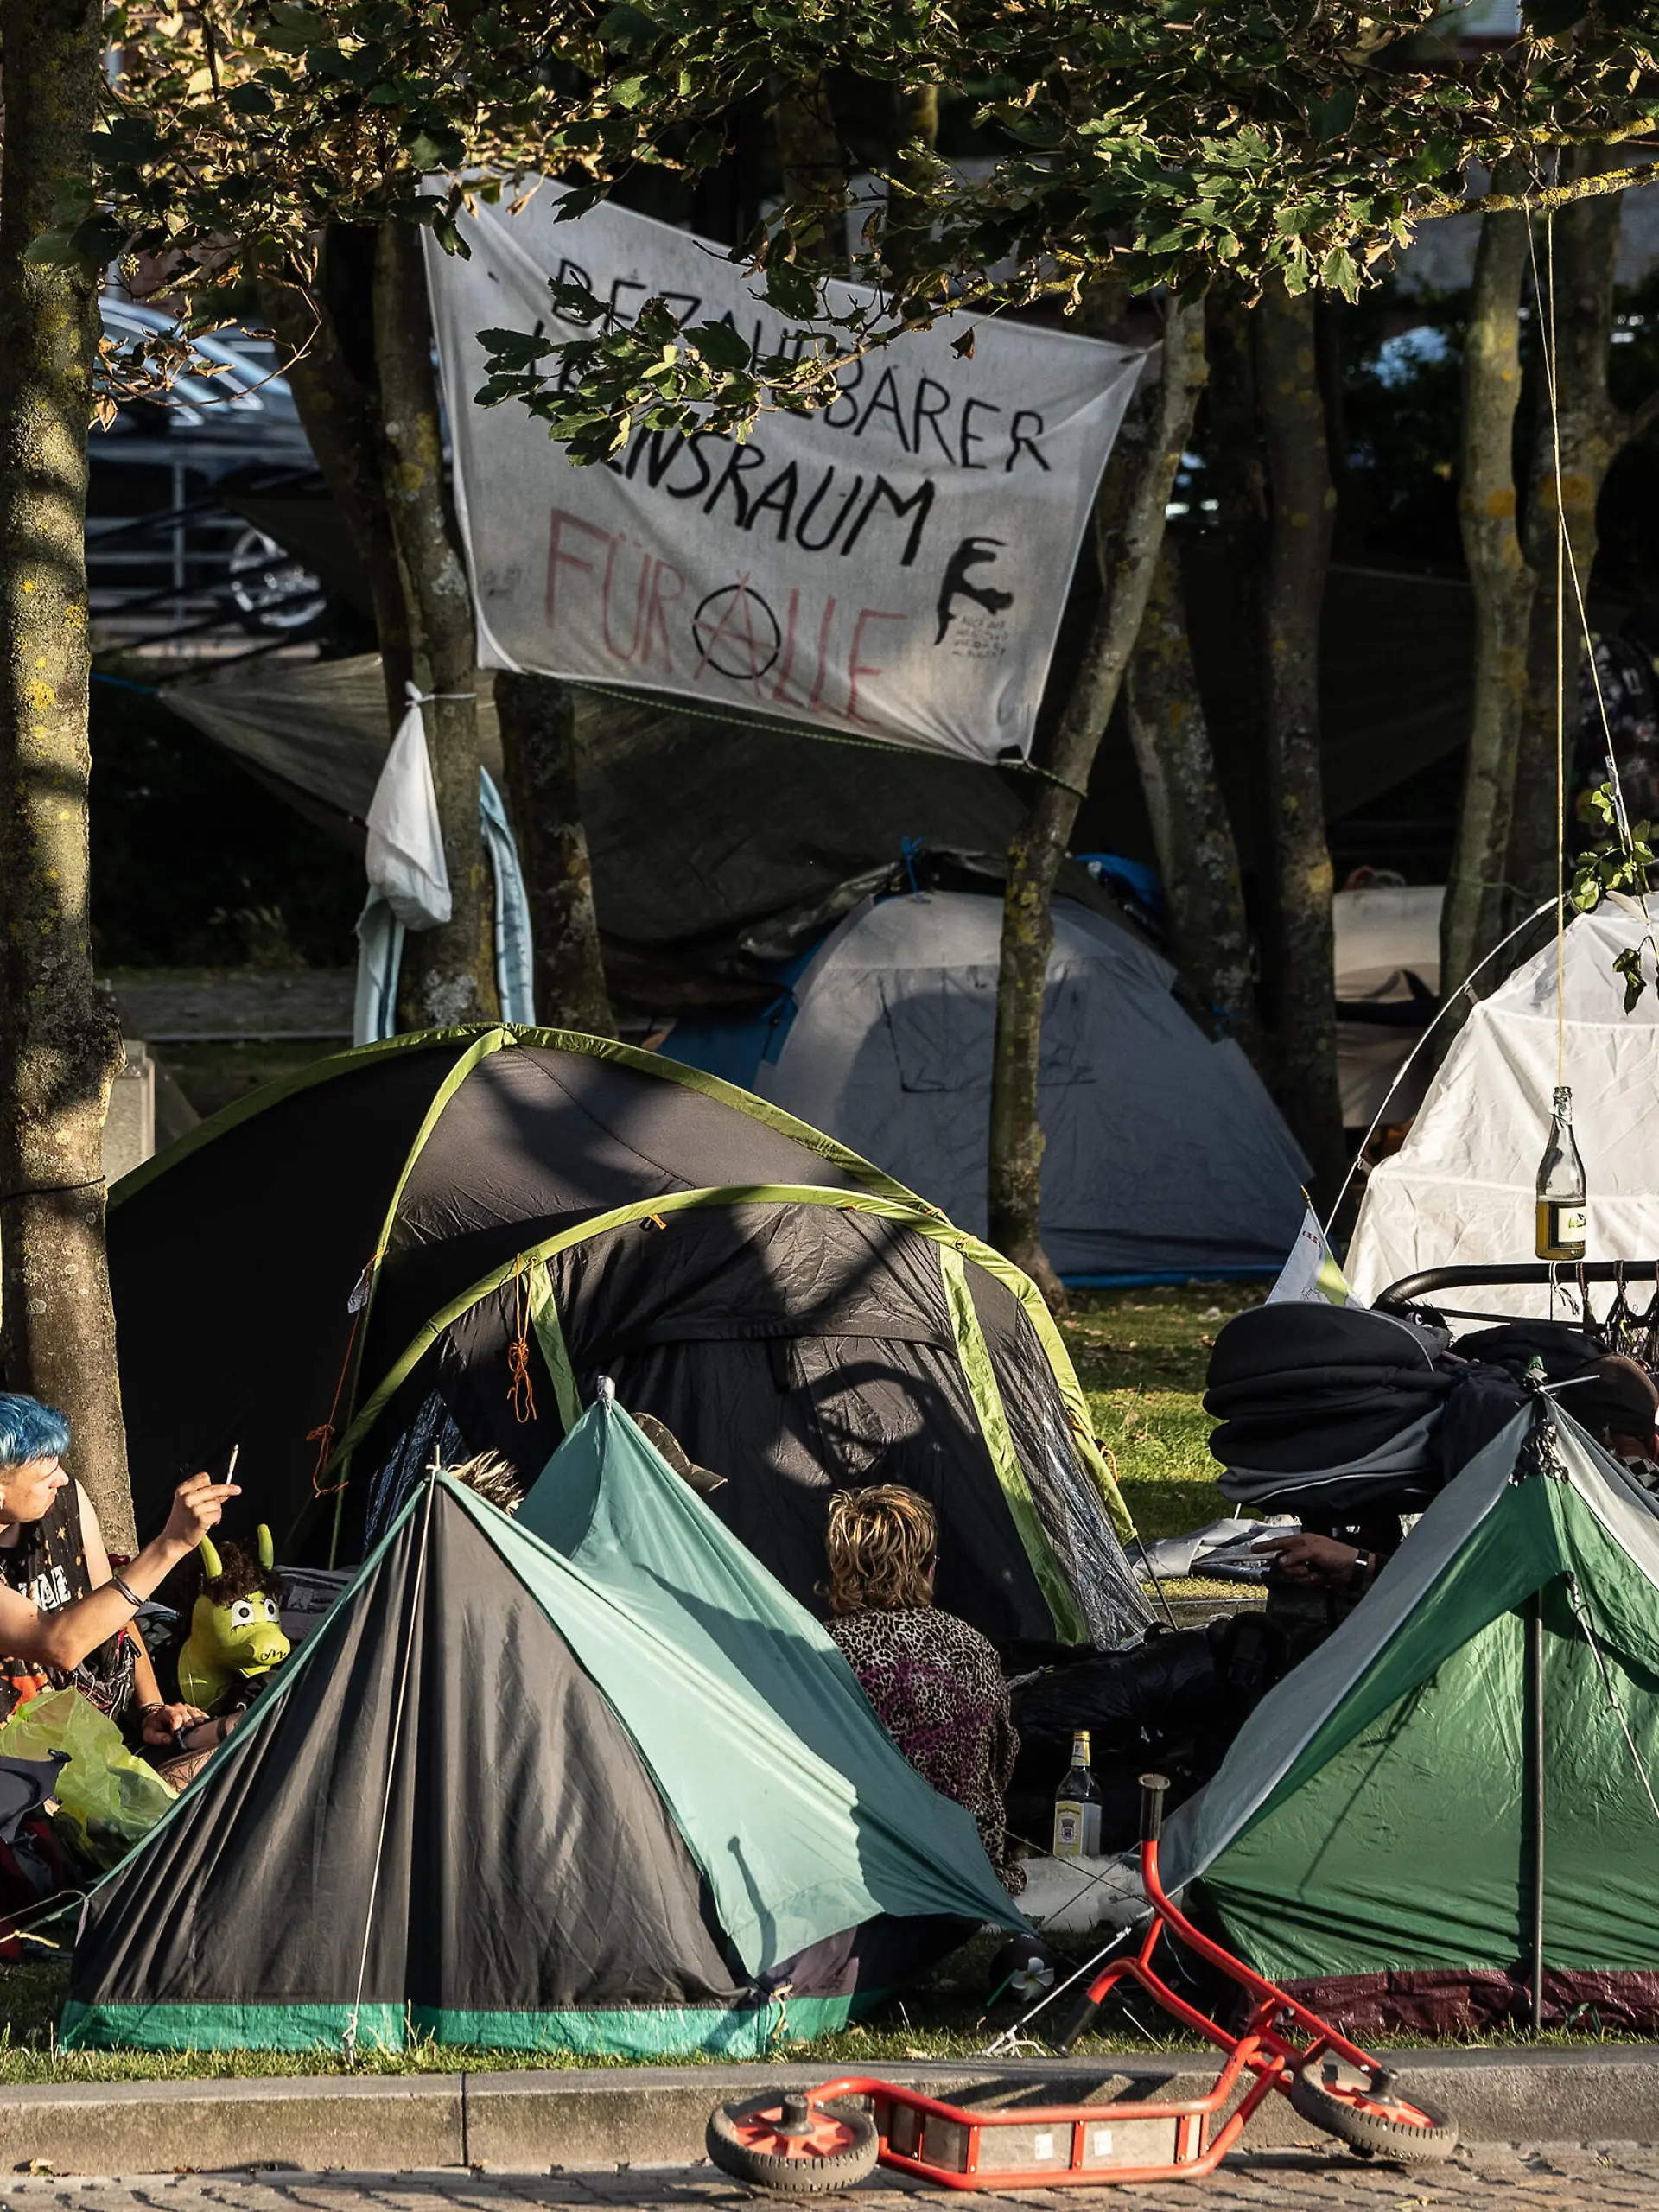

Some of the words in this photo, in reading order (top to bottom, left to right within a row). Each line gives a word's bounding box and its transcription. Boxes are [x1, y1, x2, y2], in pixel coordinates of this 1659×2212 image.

[551, 257, 1051, 472] BEZHLBARER
[544, 507, 687, 673] FÜR
[690, 569, 908, 725] ALLE
